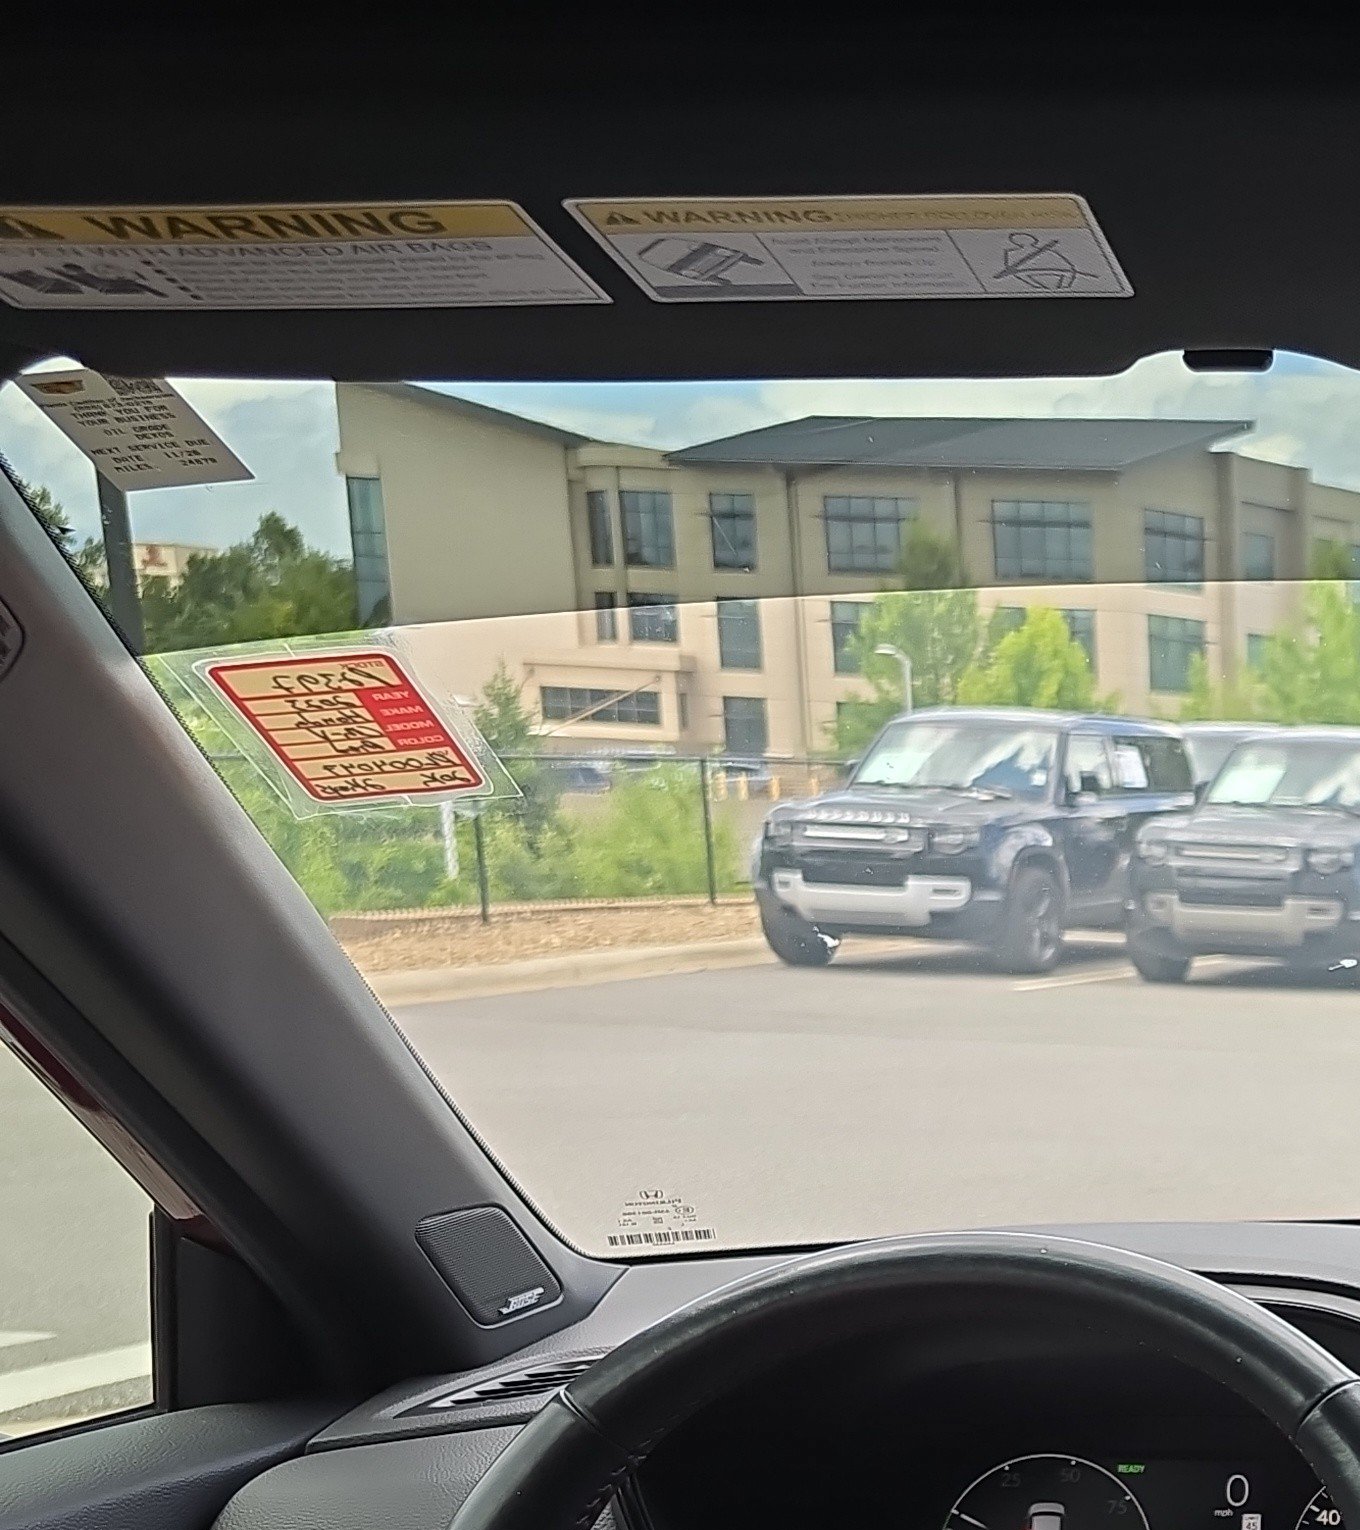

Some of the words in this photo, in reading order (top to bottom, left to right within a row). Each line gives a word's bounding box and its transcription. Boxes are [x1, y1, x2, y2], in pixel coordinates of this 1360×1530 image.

[640, 209, 833, 225] WARNING
[82, 210, 447, 240] WARNING
[176, 245, 343, 258] ADVANCED
[353, 243, 405, 256] AIR
[408, 240, 492, 253] BAGS
[127, 440, 181, 453] SERVICE
[185, 438, 211, 447] DUE
[1117, 1464, 1145, 1474] READY
[1001, 1473, 1021, 1488] 25
[1226, 1474, 1250, 1507] 0
[1107, 1500, 1128, 1515] 75
[1214, 1509, 1233, 1518] mph
[1316, 1509, 1341, 1526] 40
